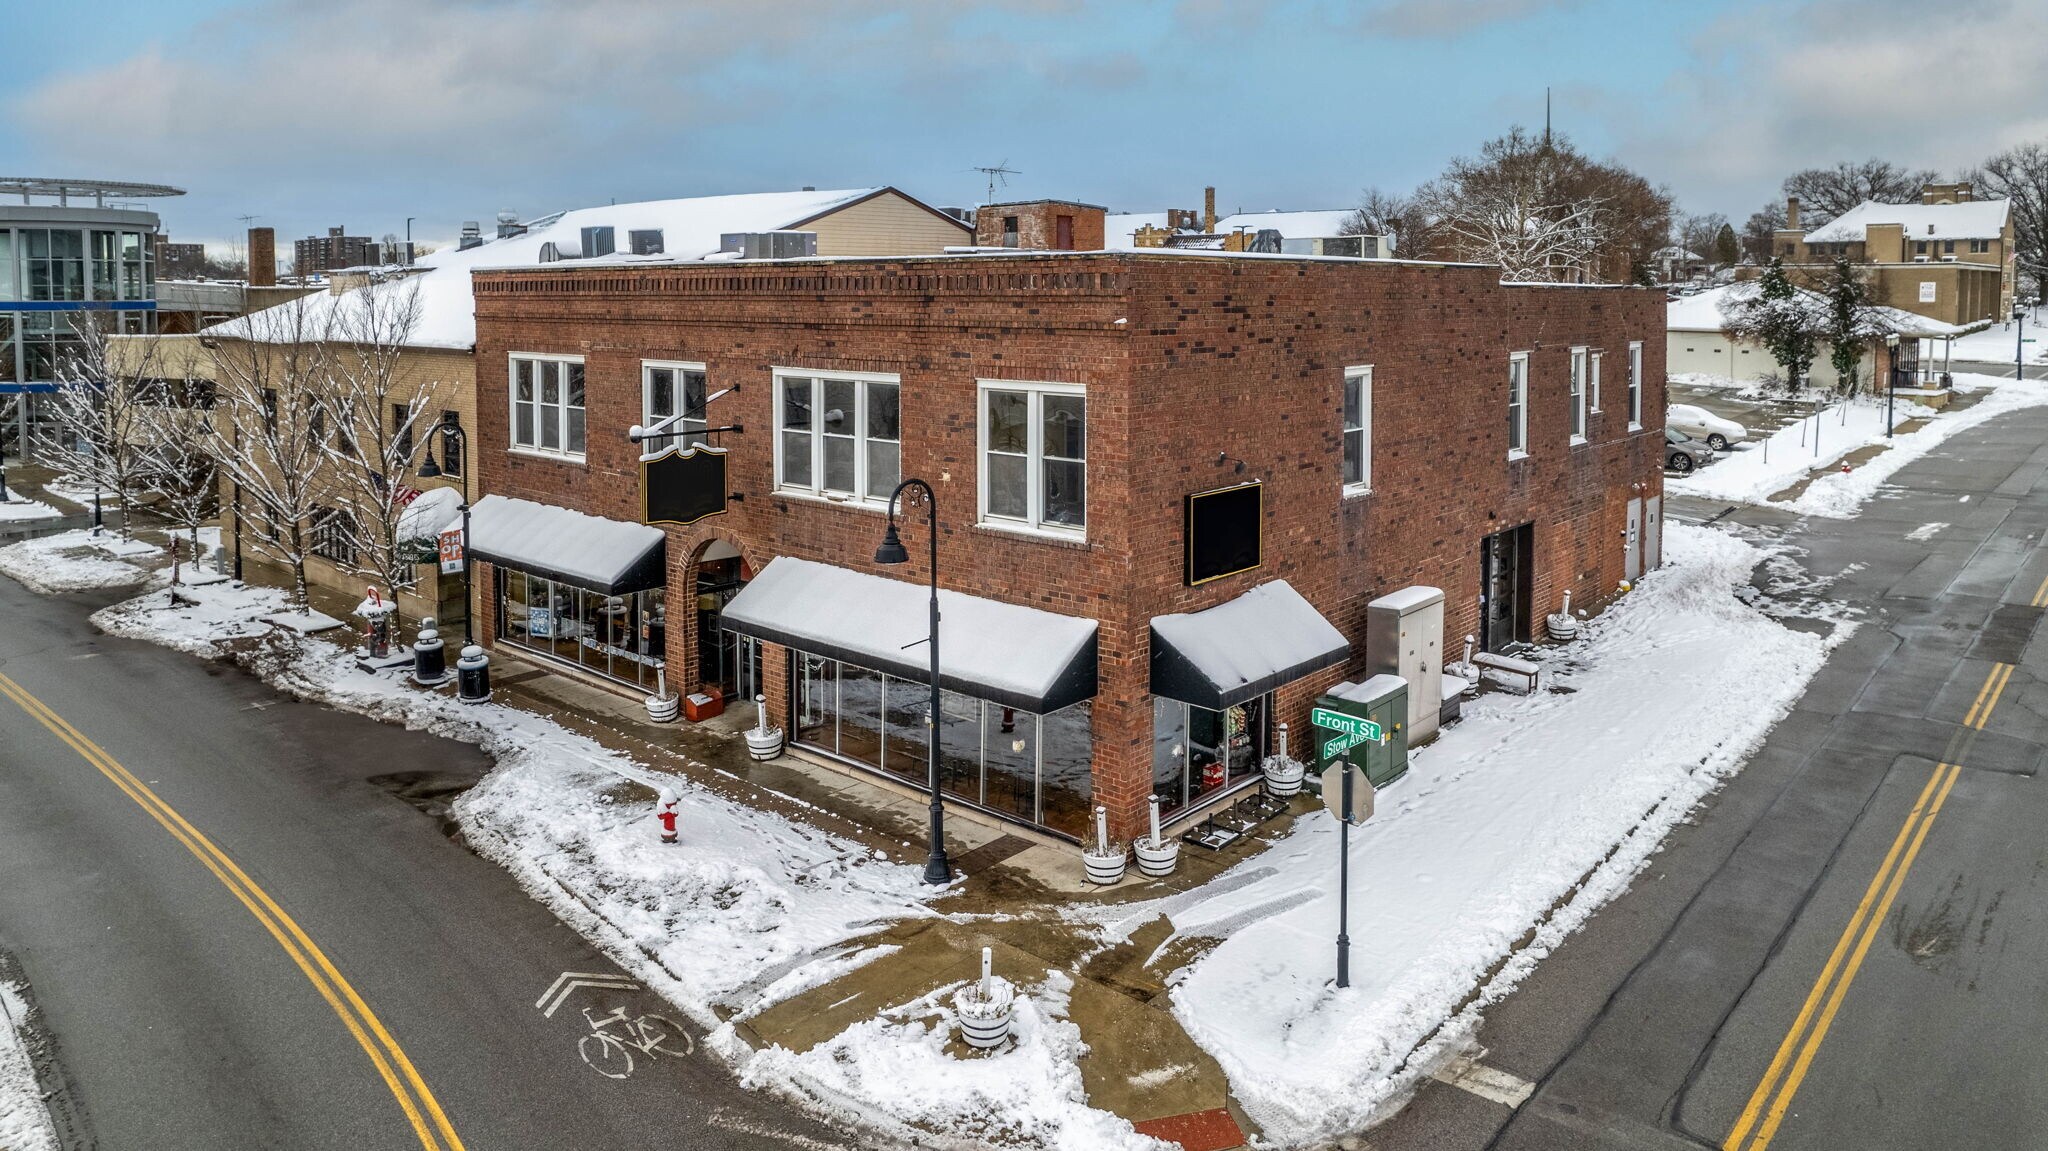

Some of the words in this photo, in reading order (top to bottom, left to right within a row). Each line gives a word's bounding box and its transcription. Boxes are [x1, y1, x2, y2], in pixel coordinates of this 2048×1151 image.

[1317, 711, 1355, 733] Front
[1360, 722, 1375, 738] St
[1327, 738, 1348, 756] Stow
[1349, 733, 1365, 746] Ave
